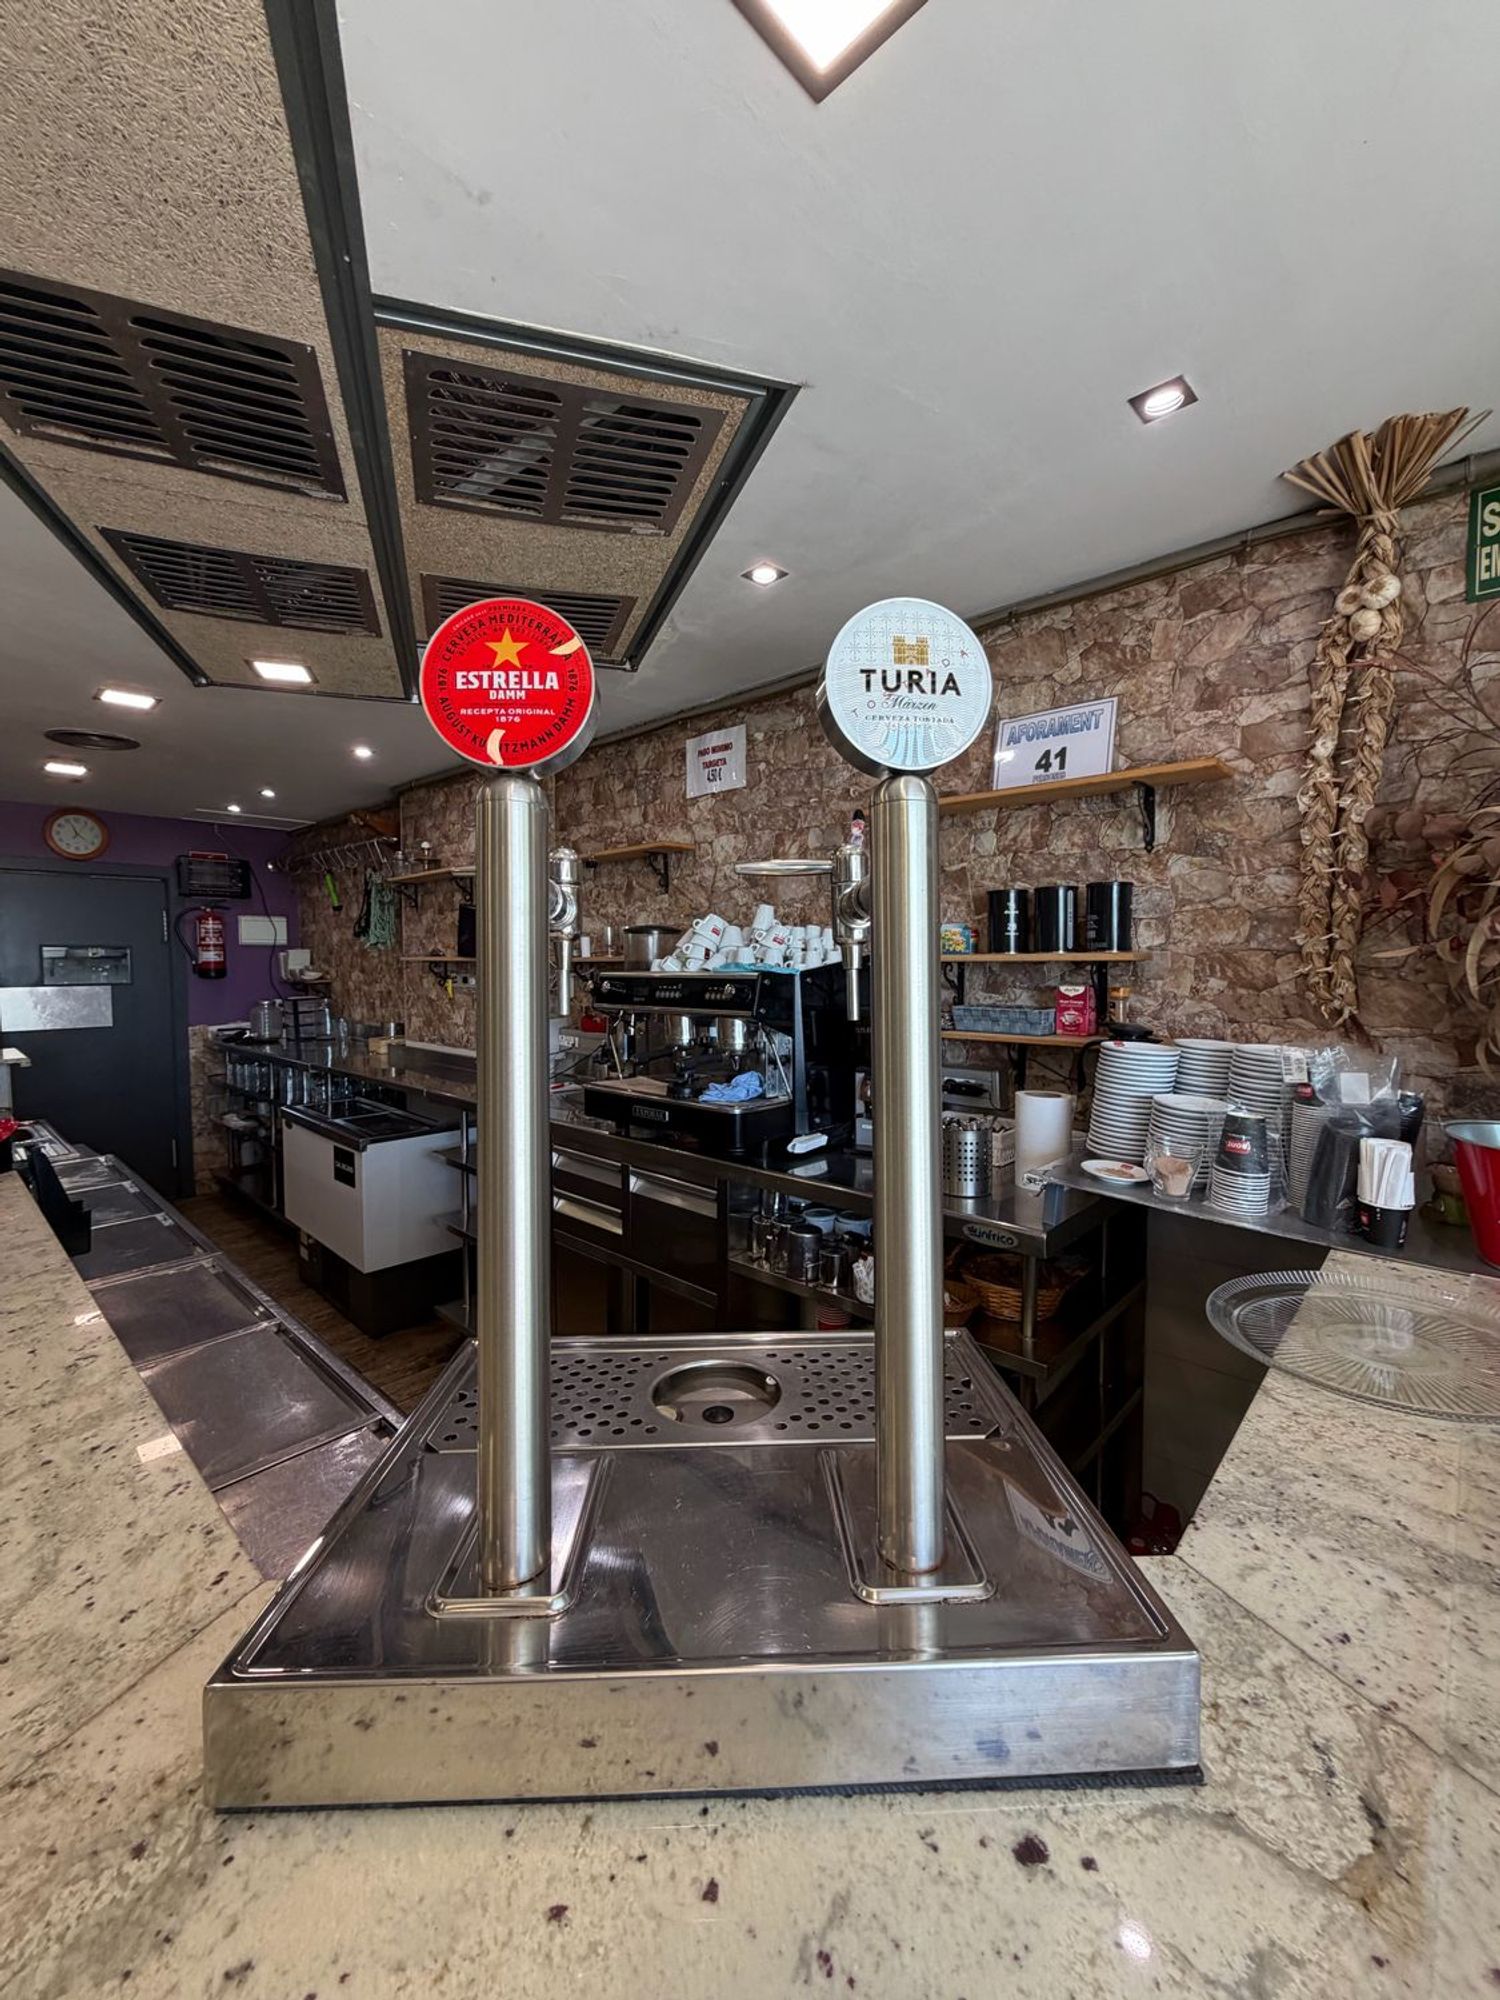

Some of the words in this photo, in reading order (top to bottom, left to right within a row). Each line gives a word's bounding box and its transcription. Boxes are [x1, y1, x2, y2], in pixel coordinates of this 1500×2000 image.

[456, 671, 559, 690] ESTRELLA
[860, 669, 962, 697] TURIA
[489, 690, 526, 700] DAMM
[439, 697, 472, 737] AUGUST
[552, 698, 577, 732] DAMM
[508, 708, 555, 716] ORIGINAL
[1006, 708, 1105, 746] AFORAMENT
[1035, 746, 1067, 773] 41
